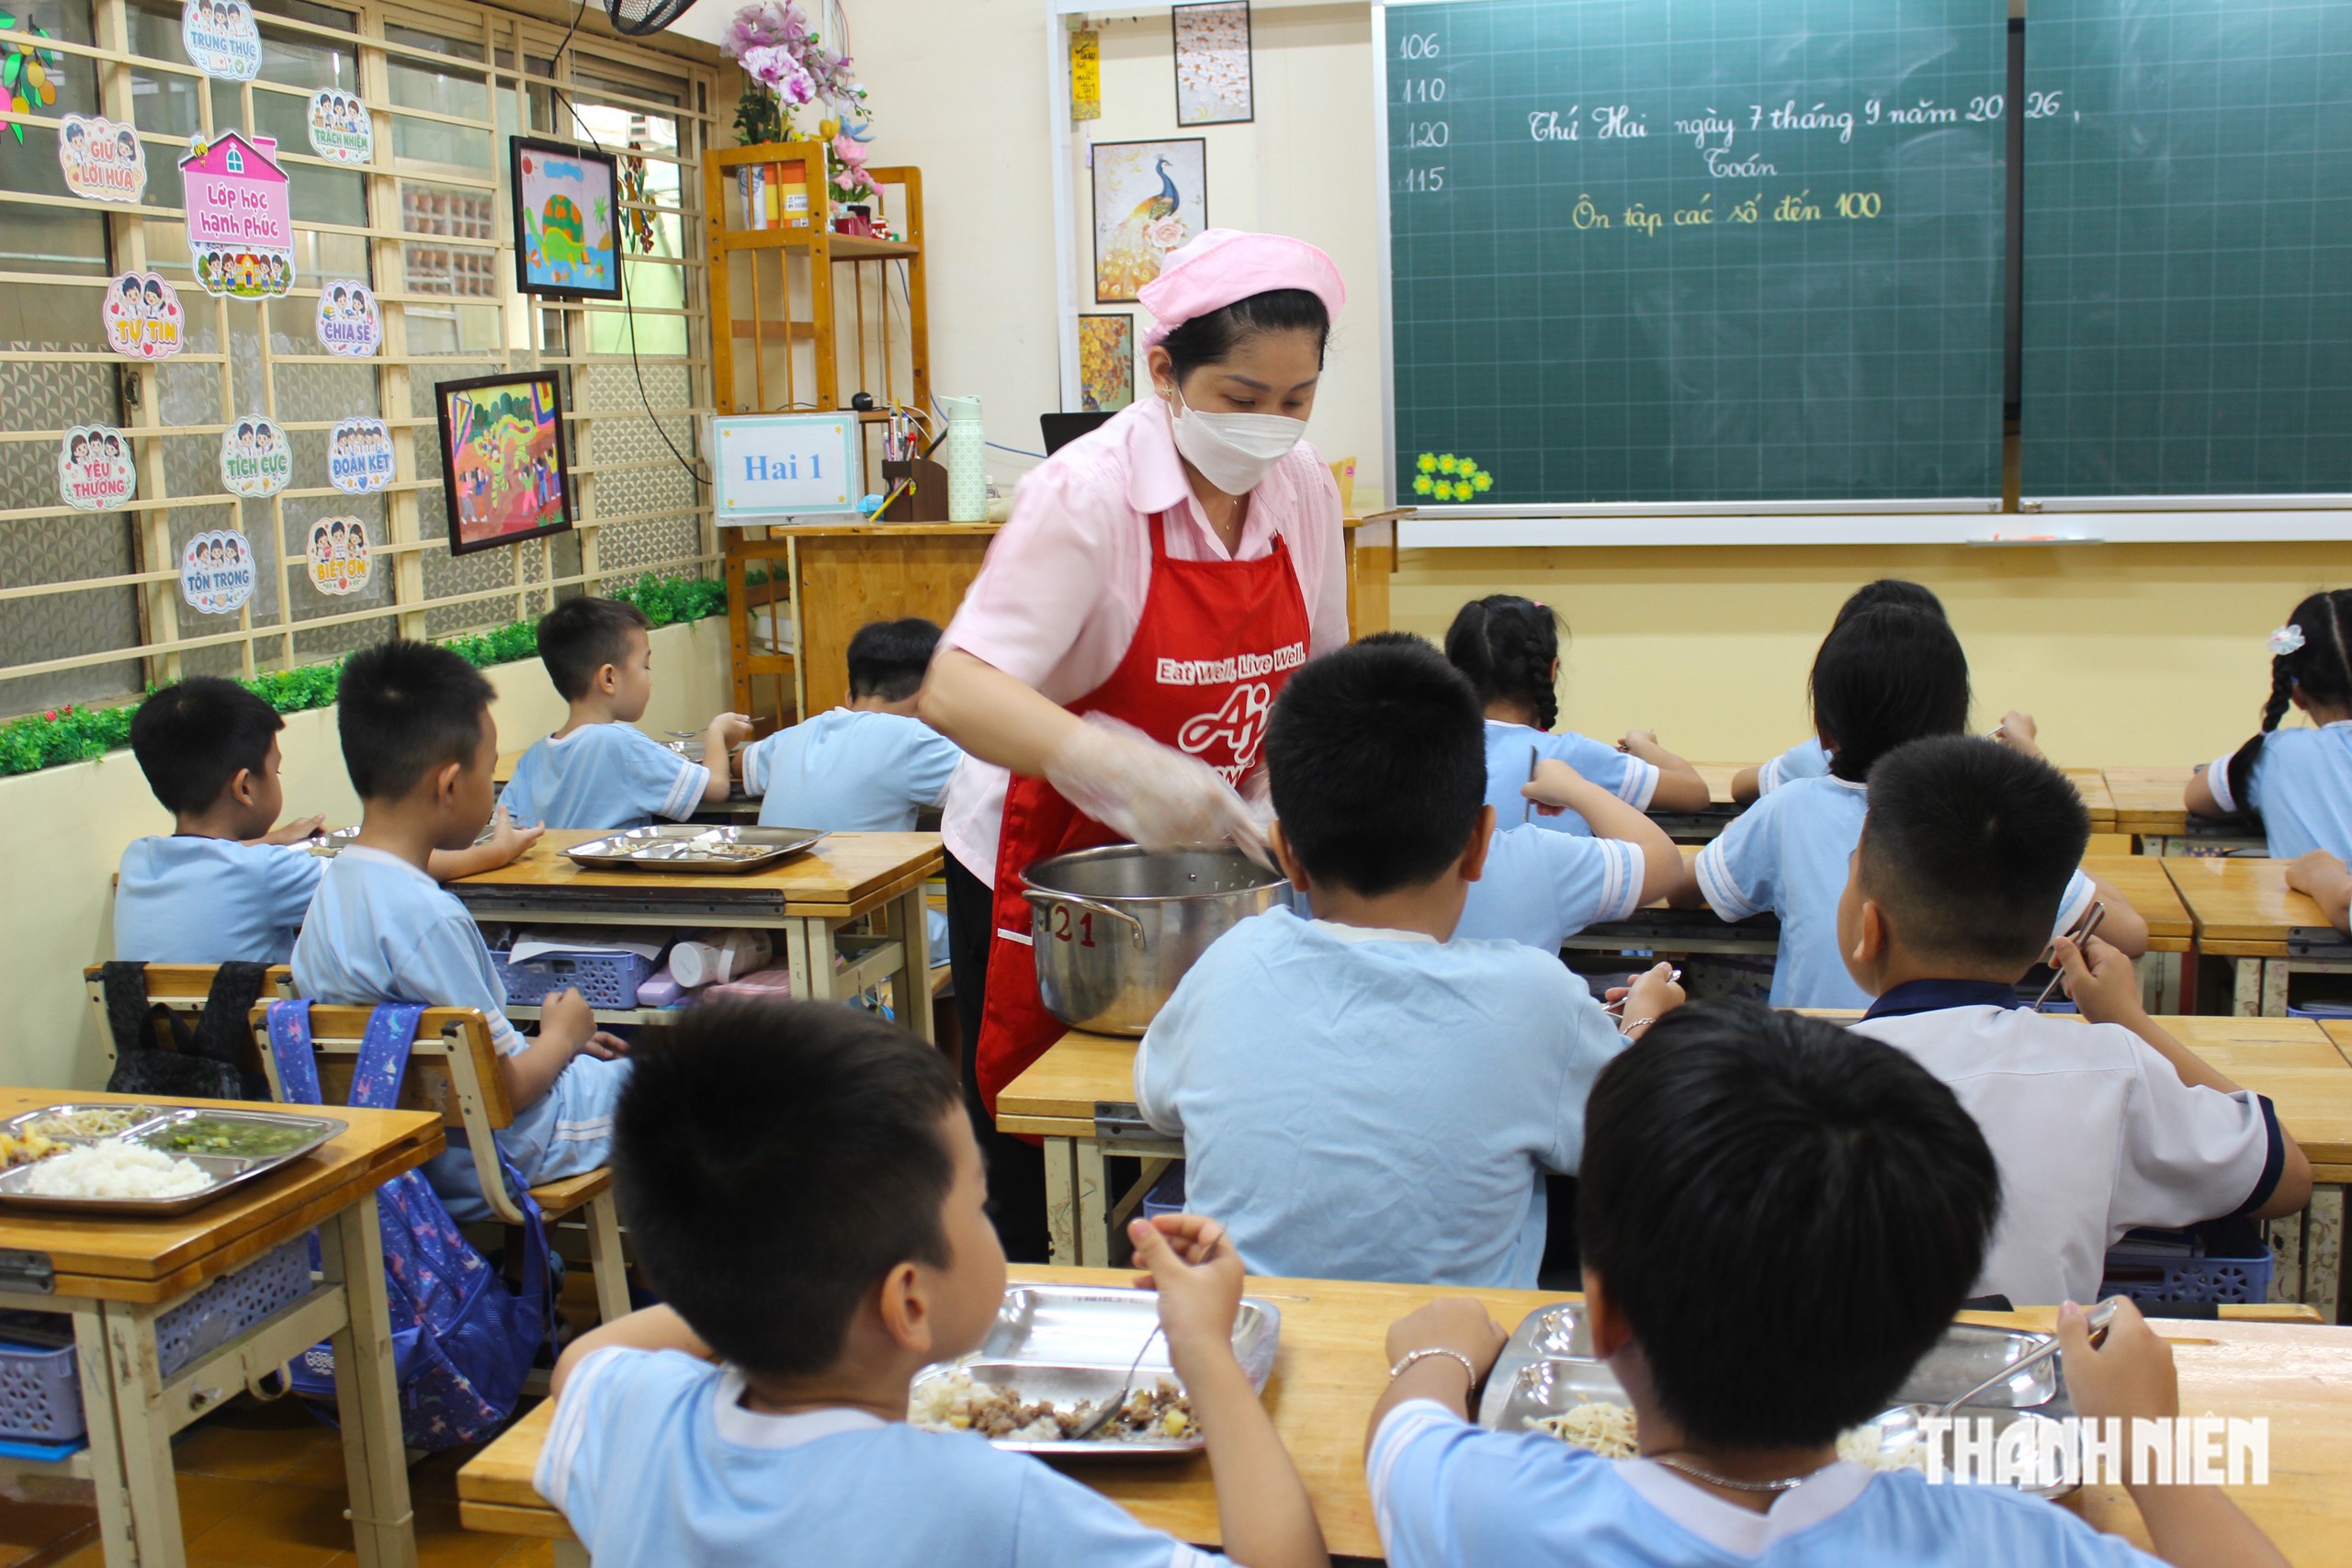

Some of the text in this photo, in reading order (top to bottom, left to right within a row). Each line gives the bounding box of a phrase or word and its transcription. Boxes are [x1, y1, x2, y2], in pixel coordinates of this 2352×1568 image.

[190, 31, 256, 60] TRUNG THỰC
[1400, 33, 1440, 59] 106
[1403, 78, 1445, 102] 110
[1408, 121, 1449, 148] 120
[1592, 105, 1648, 140] Hai
[1674, 107, 1736, 149] ngày
[1749, 105, 1762, 130] 7
[1770, 100, 1854, 143] tháng
[1864, 100, 1882, 125] 9
[1888, 100, 1957, 124] năm
[90, 139, 116, 161] GIỮ
[314, 129, 368, 152] TRÁCH NHIỆM
[1704, 148, 1777, 178] Toán
[81, 164, 135, 190] LỜI HỨA
[1406, 167, 1446, 192] 115
[208, 183, 268, 210] Lớp học
[200, 211, 279, 239] hạnh phúc
[1572, 189, 1882, 238] Ôn tập các số đến 100
[116, 319, 176, 343] TỰ TIN
[325, 322, 354, 341] CHIA
[83, 461, 111, 479] YÊU
[227, 453, 288, 479] TÍCH CỰC
[334, 447, 390, 476] ĐOÀN KẾT
[743, 453, 823, 480] Hai 1
[73, 479, 125, 499] THƯƠNG
[347, 558, 366, 576] ƠN
[187, 570, 249, 592] TÔN TRỌNG
[1156, 641, 1306, 685] Eat Well, Live Well.
[1055, 905, 1096, 948] 21
